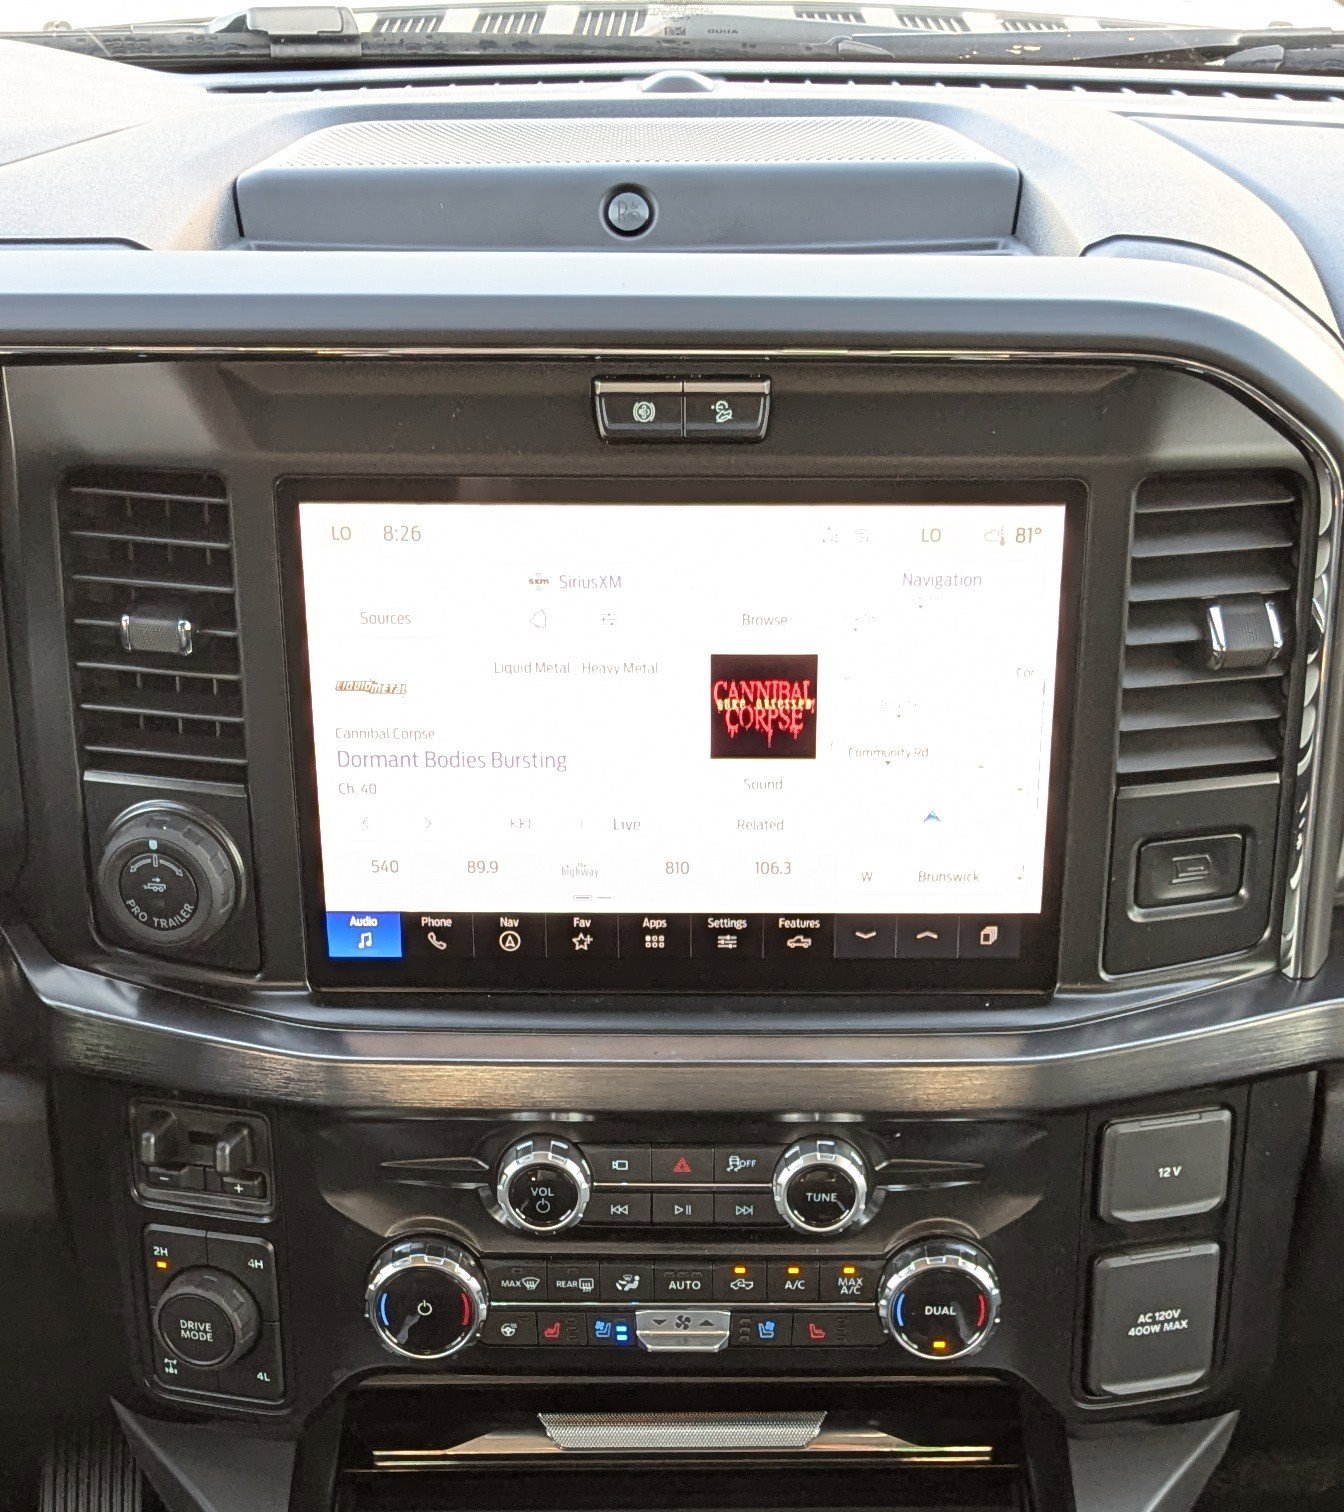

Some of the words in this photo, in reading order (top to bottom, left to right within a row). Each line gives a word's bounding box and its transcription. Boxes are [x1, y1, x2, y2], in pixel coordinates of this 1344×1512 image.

[331, 525, 352, 541] LO
[383, 525, 422, 542] 8:26
[921, 528, 942, 543] LO
[1015, 527, 1043, 544] 81°
[559, 574, 622, 590] SiriusXM
[902, 572, 982, 590] Navigation
[360, 611, 412, 625] Sources
[742, 613, 788, 626] Browse
[535, 662, 571, 675] Metal
[582, 662, 620, 677] Heavy
[623, 662, 658, 675] Metal
[713, 680, 812, 703] CANNIBAL
[725, 705, 804, 742] CORPSE
[335, 727, 390, 740] Cannibal
[393, 727, 435, 741] Corpse
[337, 750, 419, 769] Dormant
[425, 751, 486, 769] Bodies
[491, 751, 567, 772] Bursting
[361, 783, 377, 795] 40
[743, 778, 783, 790] Sound
[613, 818, 641, 831] Live
[737, 819, 784, 831] Related
[371, 860, 399, 874] 540
[467, 860, 499, 874] 89.9
[665, 861, 690, 875] 810
[755, 861, 792, 875] 106.3
[918, 870, 980, 882] Brunswick
[126, 899, 148, 922] PRO
[152, 902, 195, 929] TRAILER
[350, 916, 378, 927] Audio
[421, 916, 452, 927] Phone
[500, 917, 520, 928] Nav
[573, 917, 591, 928] Fav
[642, 917, 667, 930] Apps
[707, 917, 747, 930] Settings
[778, 917, 821, 929] Features
[1158, 1167, 1171, 1178] 12
[1173, 1165, 1182, 1176] V
[531, 1186, 554, 1197] VOL
[806, 1193, 838, 1202] TUNE
[153, 1246, 168, 1256] 2H
[248, 1259, 263, 1269] 4H
[501, 1280, 522, 1288] MAX
[556, 1280, 578, 1288] REAR
[668, 1280, 701, 1290] AUTO
[785, 1280, 805, 1290] A/C
[838, 1277, 863, 1286] MAX
[840, 1285, 861, 1294] A/C
[925, 1305, 956, 1316] DUAL
[1138, 1313, 1153, 1324] AC
[1155, 1309, 1181, 1321] 120V
[180, 1319, 212, 1332] DRIVE
[1128, 1325, 1161, 1337] 400W
[1163, 1319, 1188, 1331] MAX
[180, 1330, 213, 1342] MODE
[256, 1371, 271, 1382] 4L
